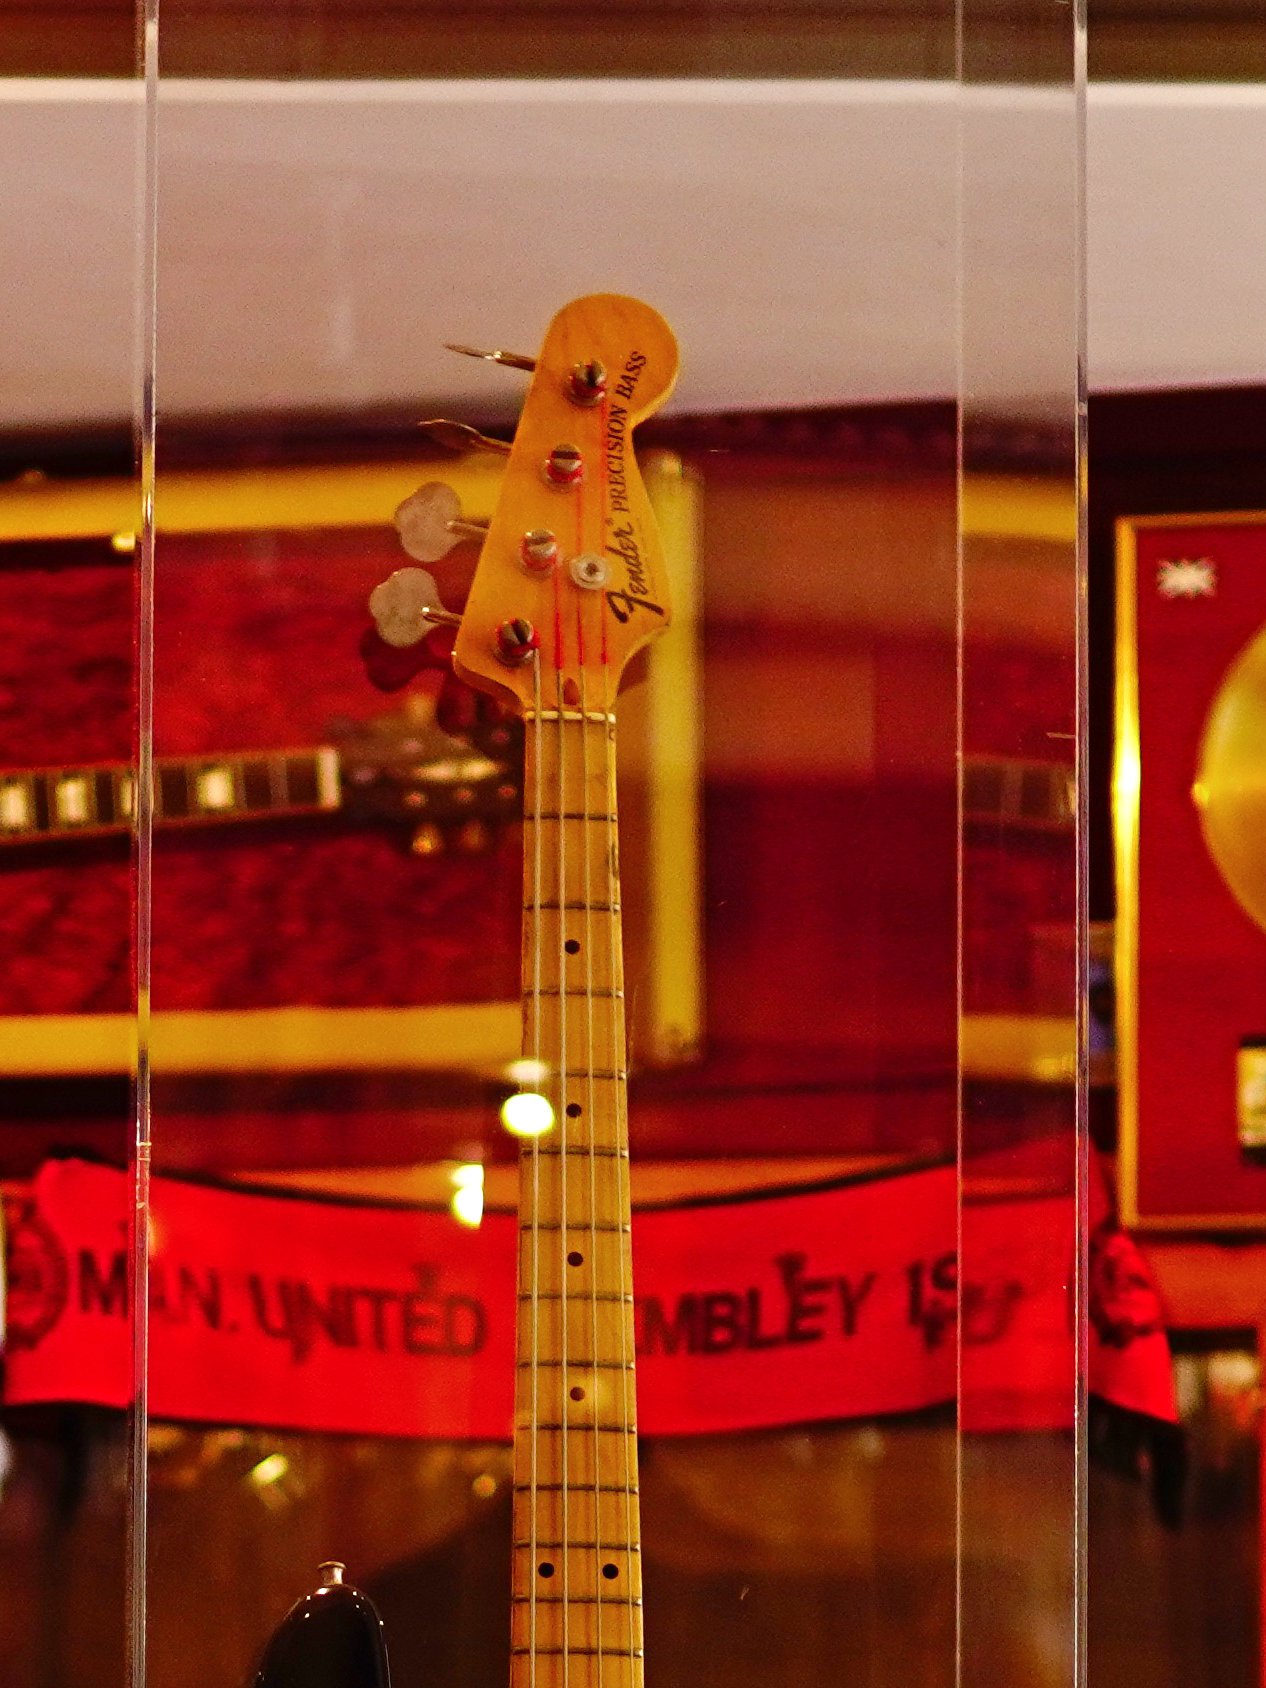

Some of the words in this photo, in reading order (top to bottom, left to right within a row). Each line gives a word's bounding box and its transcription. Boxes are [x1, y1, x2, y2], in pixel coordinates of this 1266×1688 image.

[615, 350, 647, 401] BASS
[608, 404, 629, 513] PRECISION
[607, 522, 665, 624] Fender
[248, 1272, 488, 1358] UNITED
